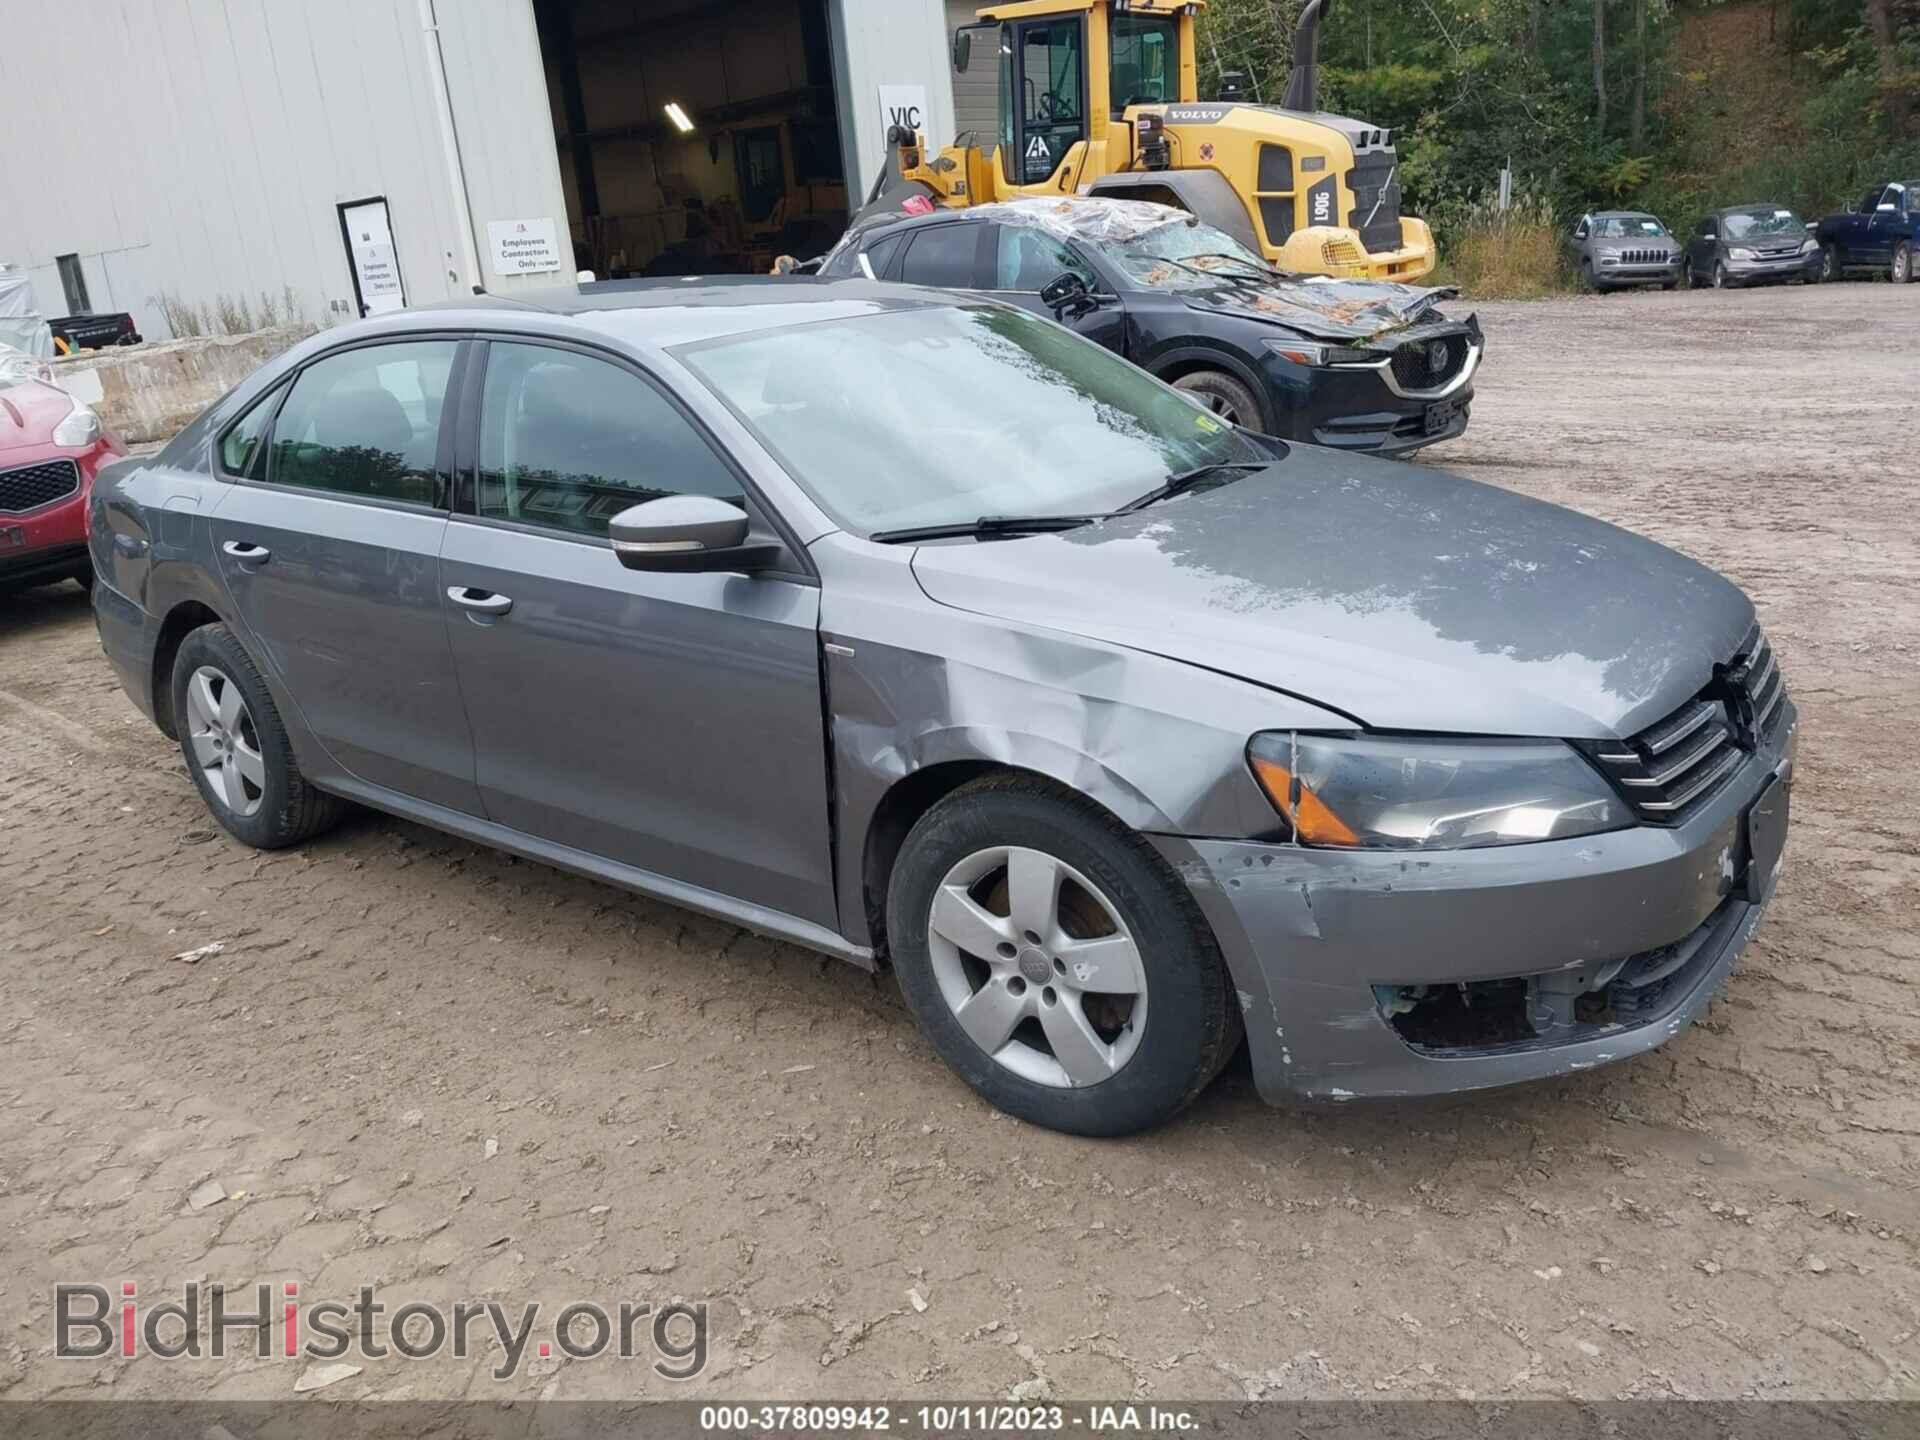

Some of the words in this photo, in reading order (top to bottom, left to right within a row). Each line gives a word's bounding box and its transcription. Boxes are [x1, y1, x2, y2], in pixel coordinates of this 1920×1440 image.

[889, 106, 921, 129] VIC
[1171, 110, 1222, 120] VOLVO
[502, 238, 545, 248] Employees
[501, 249, 549, 258] Contractors
[518, 260, 536, 268] Only
